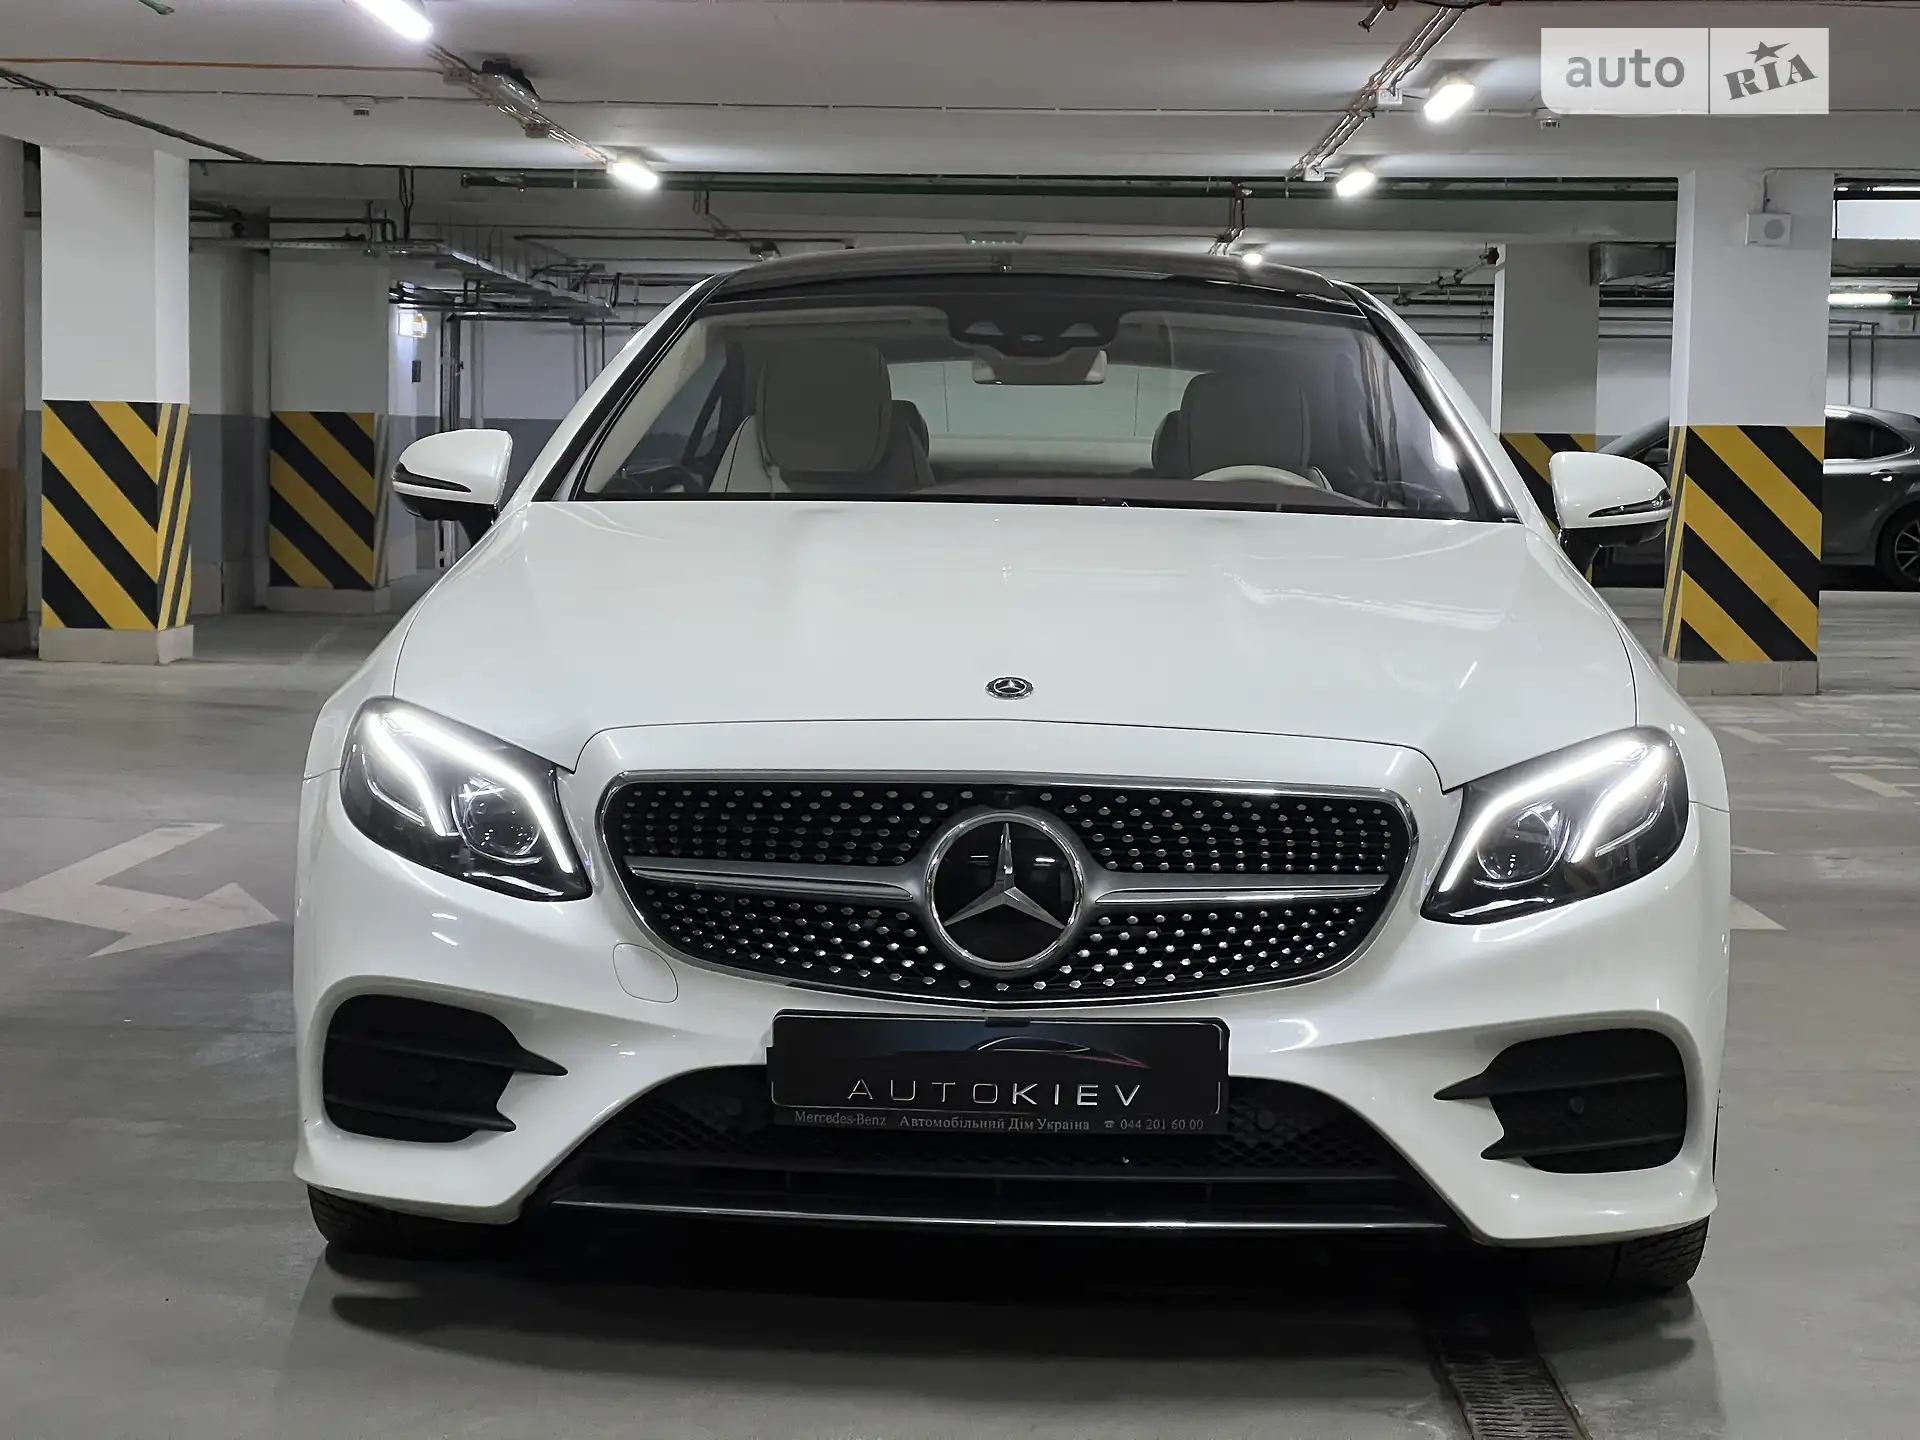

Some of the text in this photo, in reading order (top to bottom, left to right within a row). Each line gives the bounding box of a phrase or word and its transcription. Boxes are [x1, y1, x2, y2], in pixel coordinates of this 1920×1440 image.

[847, 1078, 1141, 1107] AUTOKIEV
[794, 1110, 887, 1127] Mercedes-Benz
[899, 1115, 1006, 1130] Автомобільний
[1008, 1116, 1035, 1131] Дім
[1120, 1118, 1142, 1130] 044
[1146, 1118, 1167, 1131] 201
[1171, 1119, 1187, 1131] 60
[1189, 1118, 1205, 1131] 00
